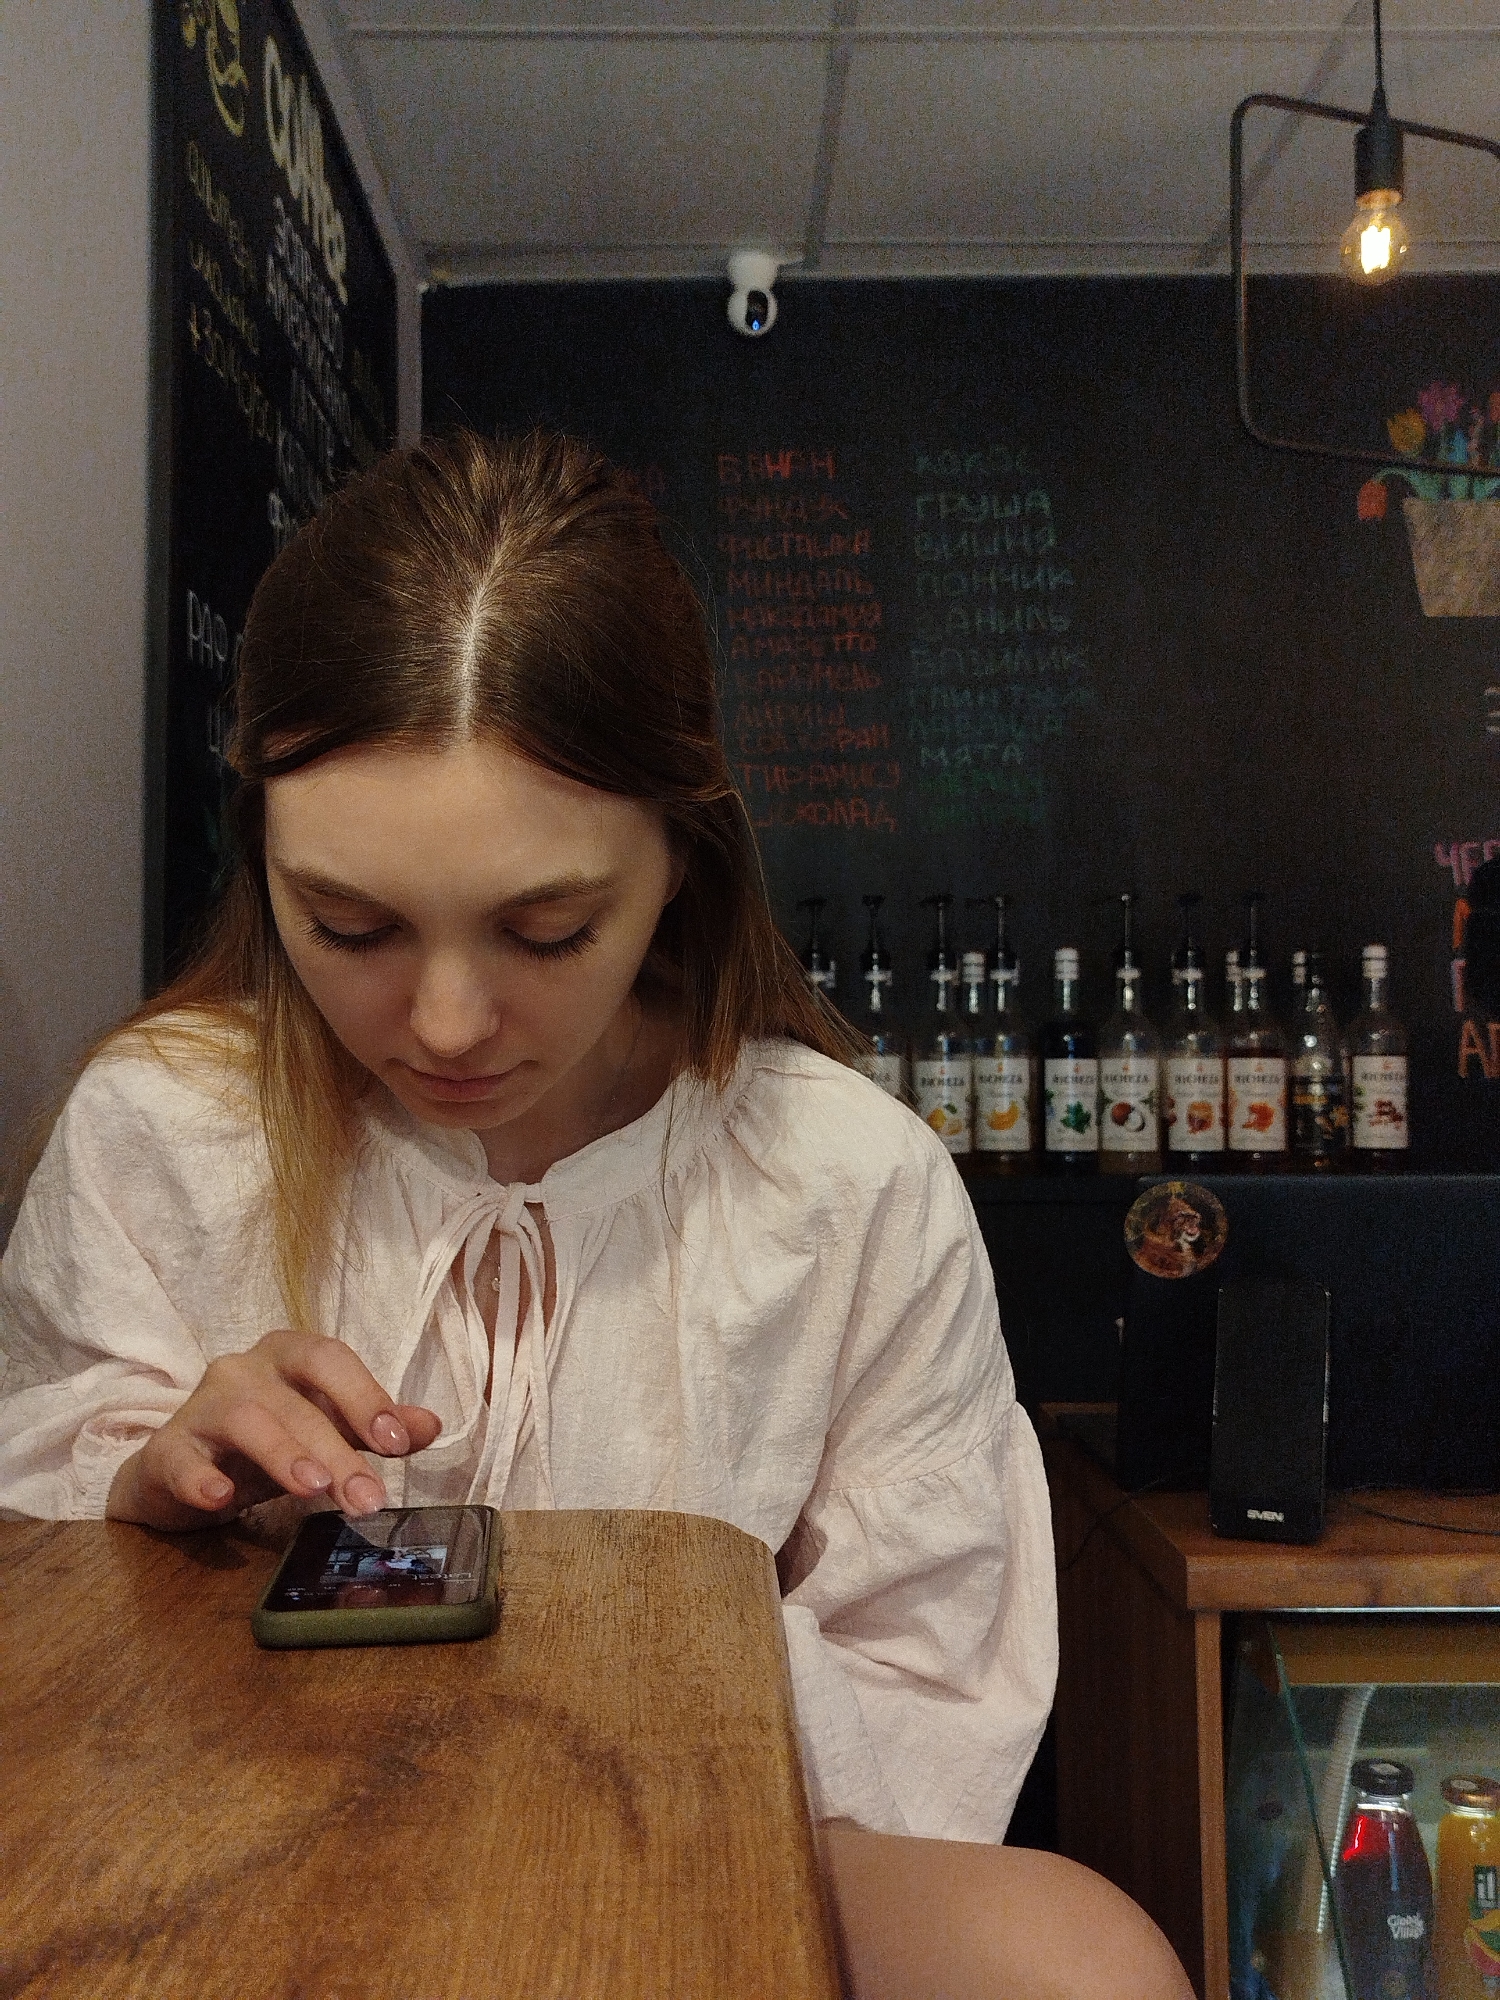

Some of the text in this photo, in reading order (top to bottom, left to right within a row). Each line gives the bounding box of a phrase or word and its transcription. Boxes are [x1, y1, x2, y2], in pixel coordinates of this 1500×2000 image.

[915, 489, 1052, 523] ГРУША
[726, 566, 874, 599] МИНДАЛЬ
[919, 744, 1023, 768] МЯТА
[1246, 1508, 1285, 1523] SVEN
